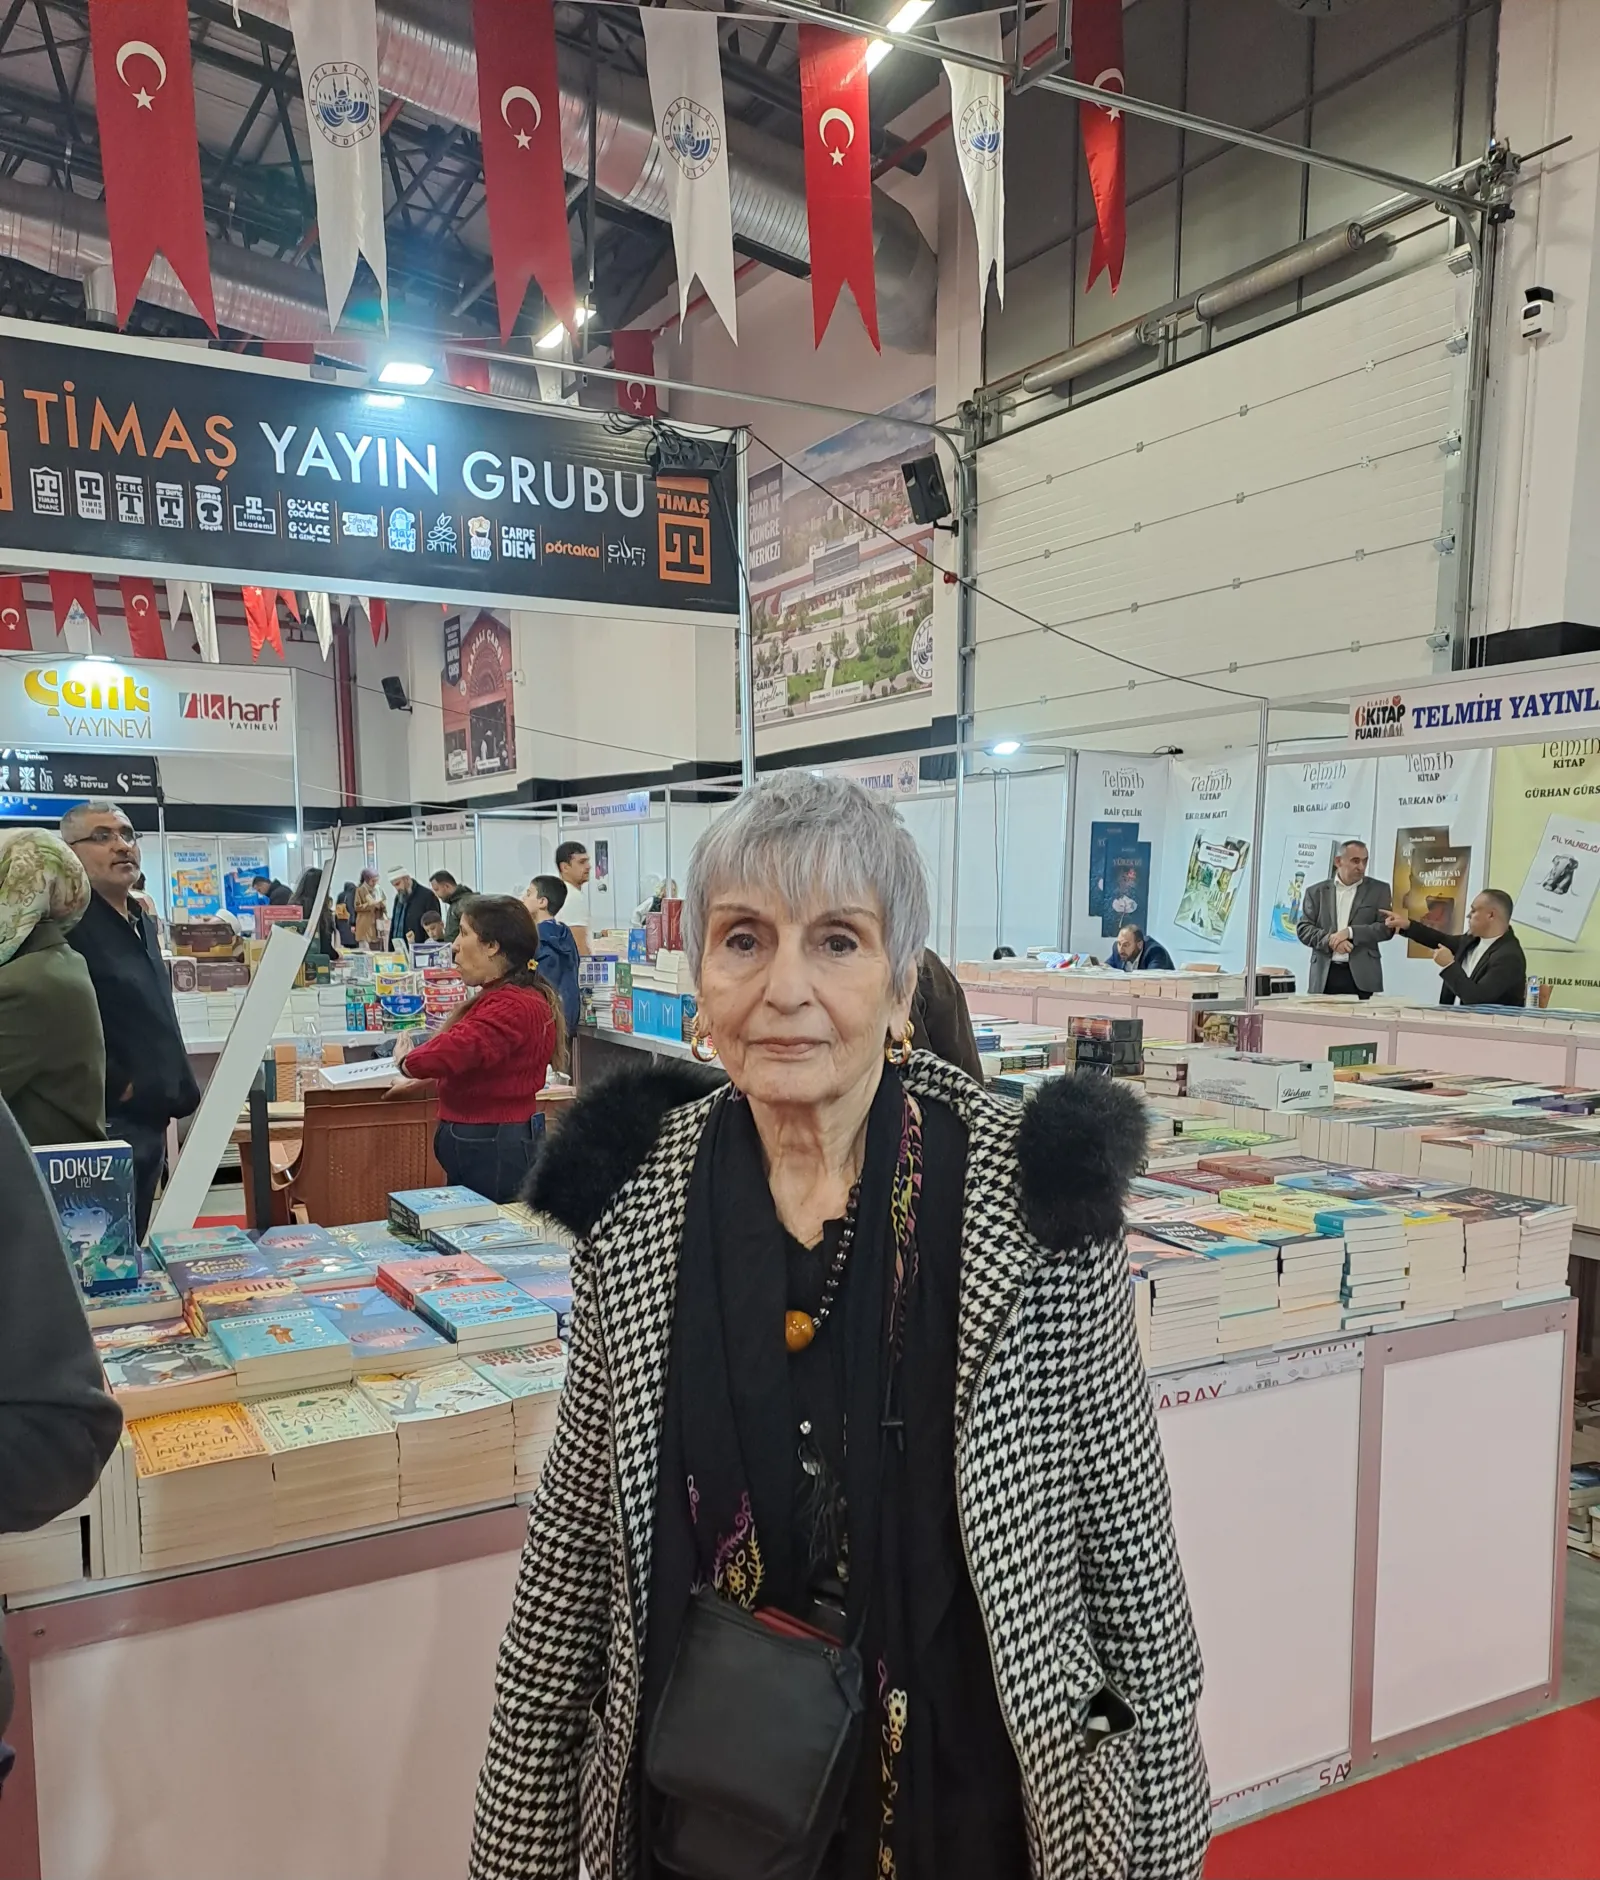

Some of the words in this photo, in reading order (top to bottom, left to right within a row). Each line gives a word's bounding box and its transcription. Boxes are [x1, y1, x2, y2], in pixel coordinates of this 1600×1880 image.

[23, 380, 238, 482] TİMAŞ
[258, 420, 439, 496] YAYIN
[461, 450, 646, 518] GRUBU
[286, 498, 330, 514] GÜLCE
[656, 489, 710, 519] TİMAŞ
[237, 521, 273, 531] akademi
[288, 521, 331, 537] GÜLCE
[749, 517, 780, 547] KONGRE
[501, 526, 536, 542] CARPE
[24, 668, 150, 717] Çelik
[1411, 692, 1504, 730] TELMİH
[1508, 686, 1600, 720] YAYINL
[63, 715, 152, 740] YAYINEVİ
[229, 721, 279, 732] YAYINEVİ
[1354, 726, 1382, 741] FUARI
[1552, 757, 1586, 769] KİTAP
[1417, 772, 1441, 782] KİTAP
[1112, 788, 1135, 798] KİTAP
[1524, 786, 1571, 799] GÜRHAN
[1398, 795, 1434, 806] TARKAN
[1121, 806, 1143, 818] ÇELİK
[1548, 976, 1573, 987] BİRAZ
[1574, 978, 1600, 988] MUHA
[49, 1155, 115, 1185] DOKUZ
